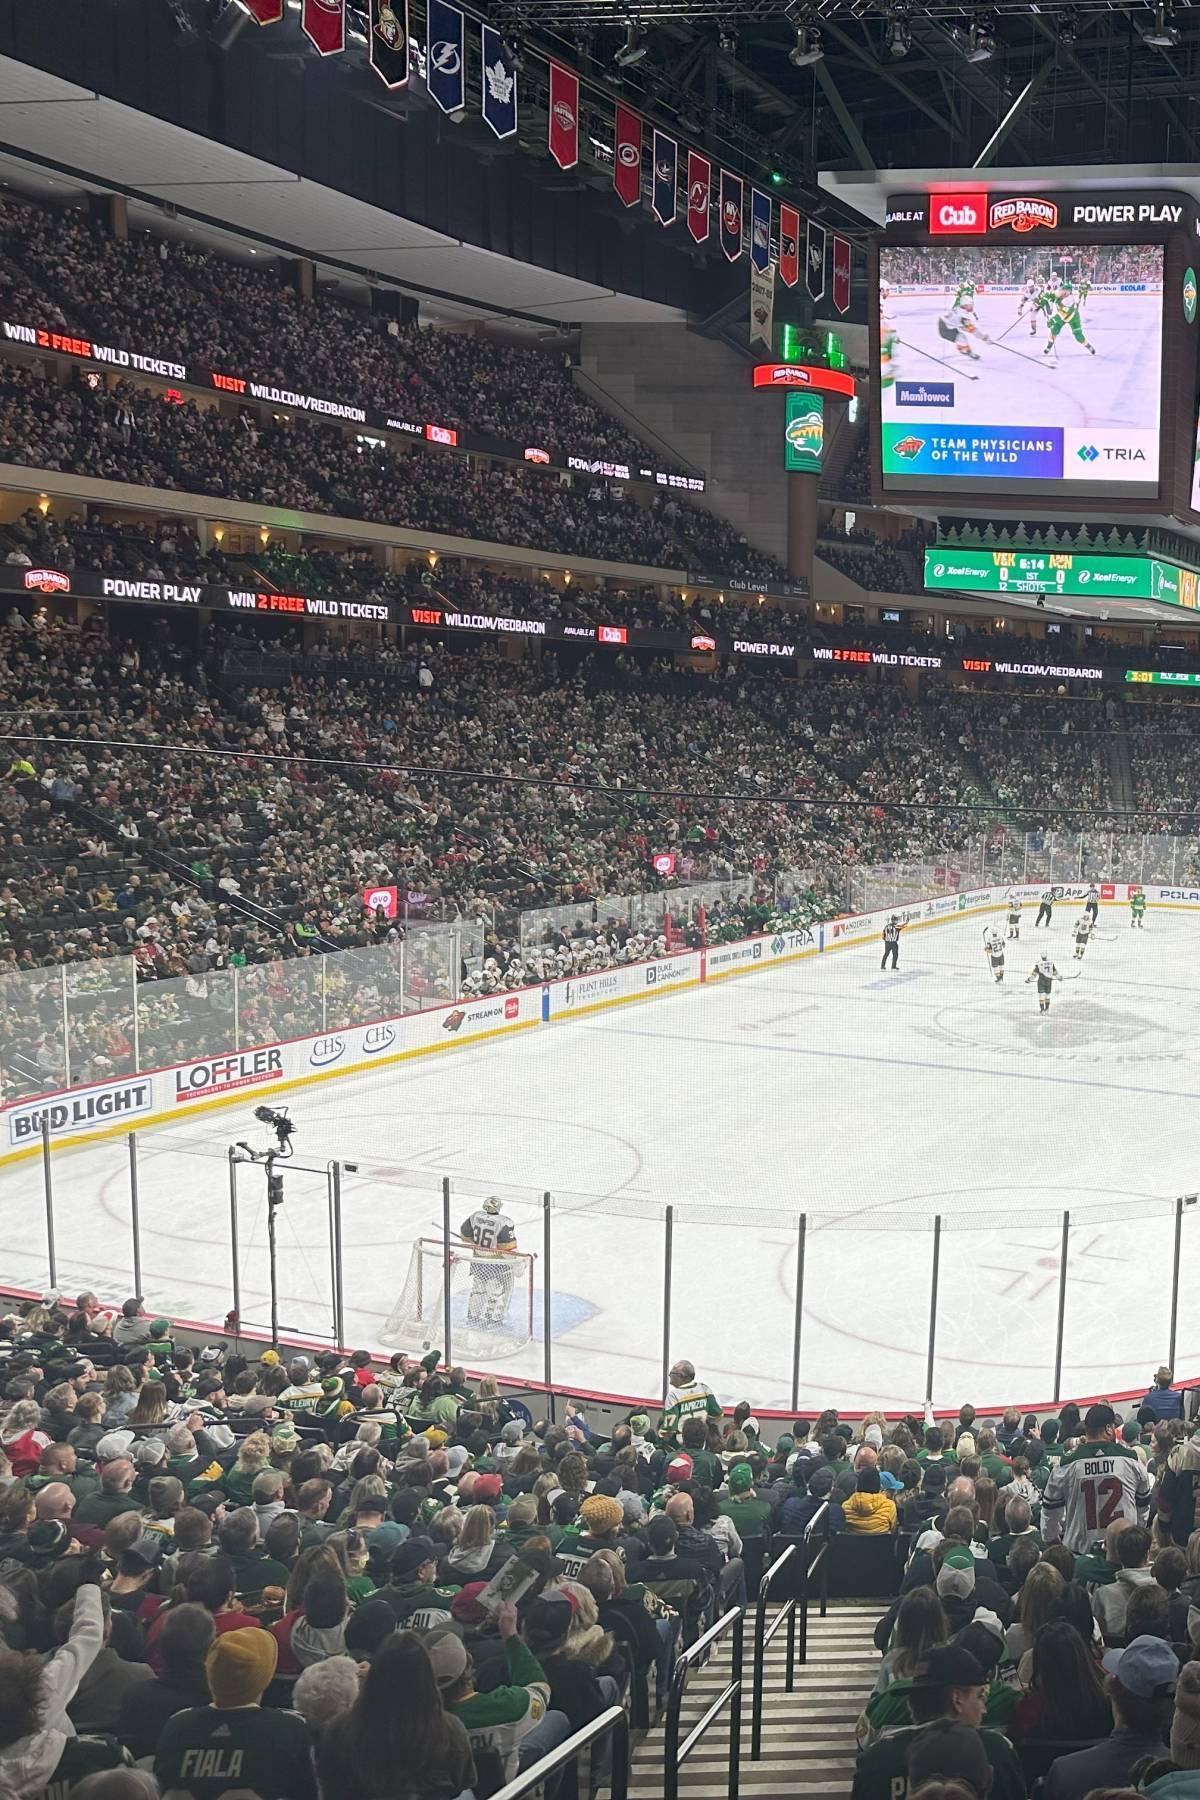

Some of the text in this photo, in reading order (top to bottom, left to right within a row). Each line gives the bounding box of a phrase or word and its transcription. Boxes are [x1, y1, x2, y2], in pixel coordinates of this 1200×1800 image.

[913, 212, 924, 221] AT
[940, 206, 976, 225] Cub
[993, 202, 1054, 221] RED BARON
[1073, 206, 1182, 223] POWER PLAY
[1120, 284, 1146, 292] ECOLAB
[4, 322, 187, 380] WIN 2 FREE WILD TICKETS!
[211, 374, 366, 423] VISIT WILD.COM/REDBARON
[901, 389, 949, 402] Manitowoc
[931, 438, 1053, 452] TEAM PHYSICIANS
[931, 450, 1018, 463] OF THE WILD
[1103, 448, 1145, 461] TRIA
[1000, 567, 1008, 582] 0
[1056, 570, 1065, 584] 0
[103, 579, 201, 602] POWER PLAY
[729, 580, 768, 592] Club Level
[1016, 583, 1046, 592] SHOTS
[228, 592, 388, 620] WIN 2 FREE WILD TICKETS!
[412, 609, 546, 634] VISIT WILD.COM/REDBARON
[734, 641, 795, 656] POWER PLAY
[813, 648, 942, 668] WIN 2 FREE WILD TICKETS!
[963, 660, 1103, 679] VISIT WILD.COM/REDBARON
[787, 929, 815, 949] TRIA
[657, 969, 681, 981] CANNON
[658, 963, 672, 973] DUKE
[580, 981, 598, 994] FLINT
[600, 976, 617, 989] HILLS
[468, 1009, 493, 1022] STREAM
[494, 1007, 503, 1016] ON
[366, 1025, 394, 1044] CHS
[313, 1036, 343, 1057] CHS
[176, 1049, 282, 1093] LOFFLER
[15, 1085, 147, 1138] BUD LIGHT
[1084, 1460, 1115, 1476] BOLDY
[1080, 1477, 1124, 1531] 12
[181, 1749, 243, 1779] FIALA
